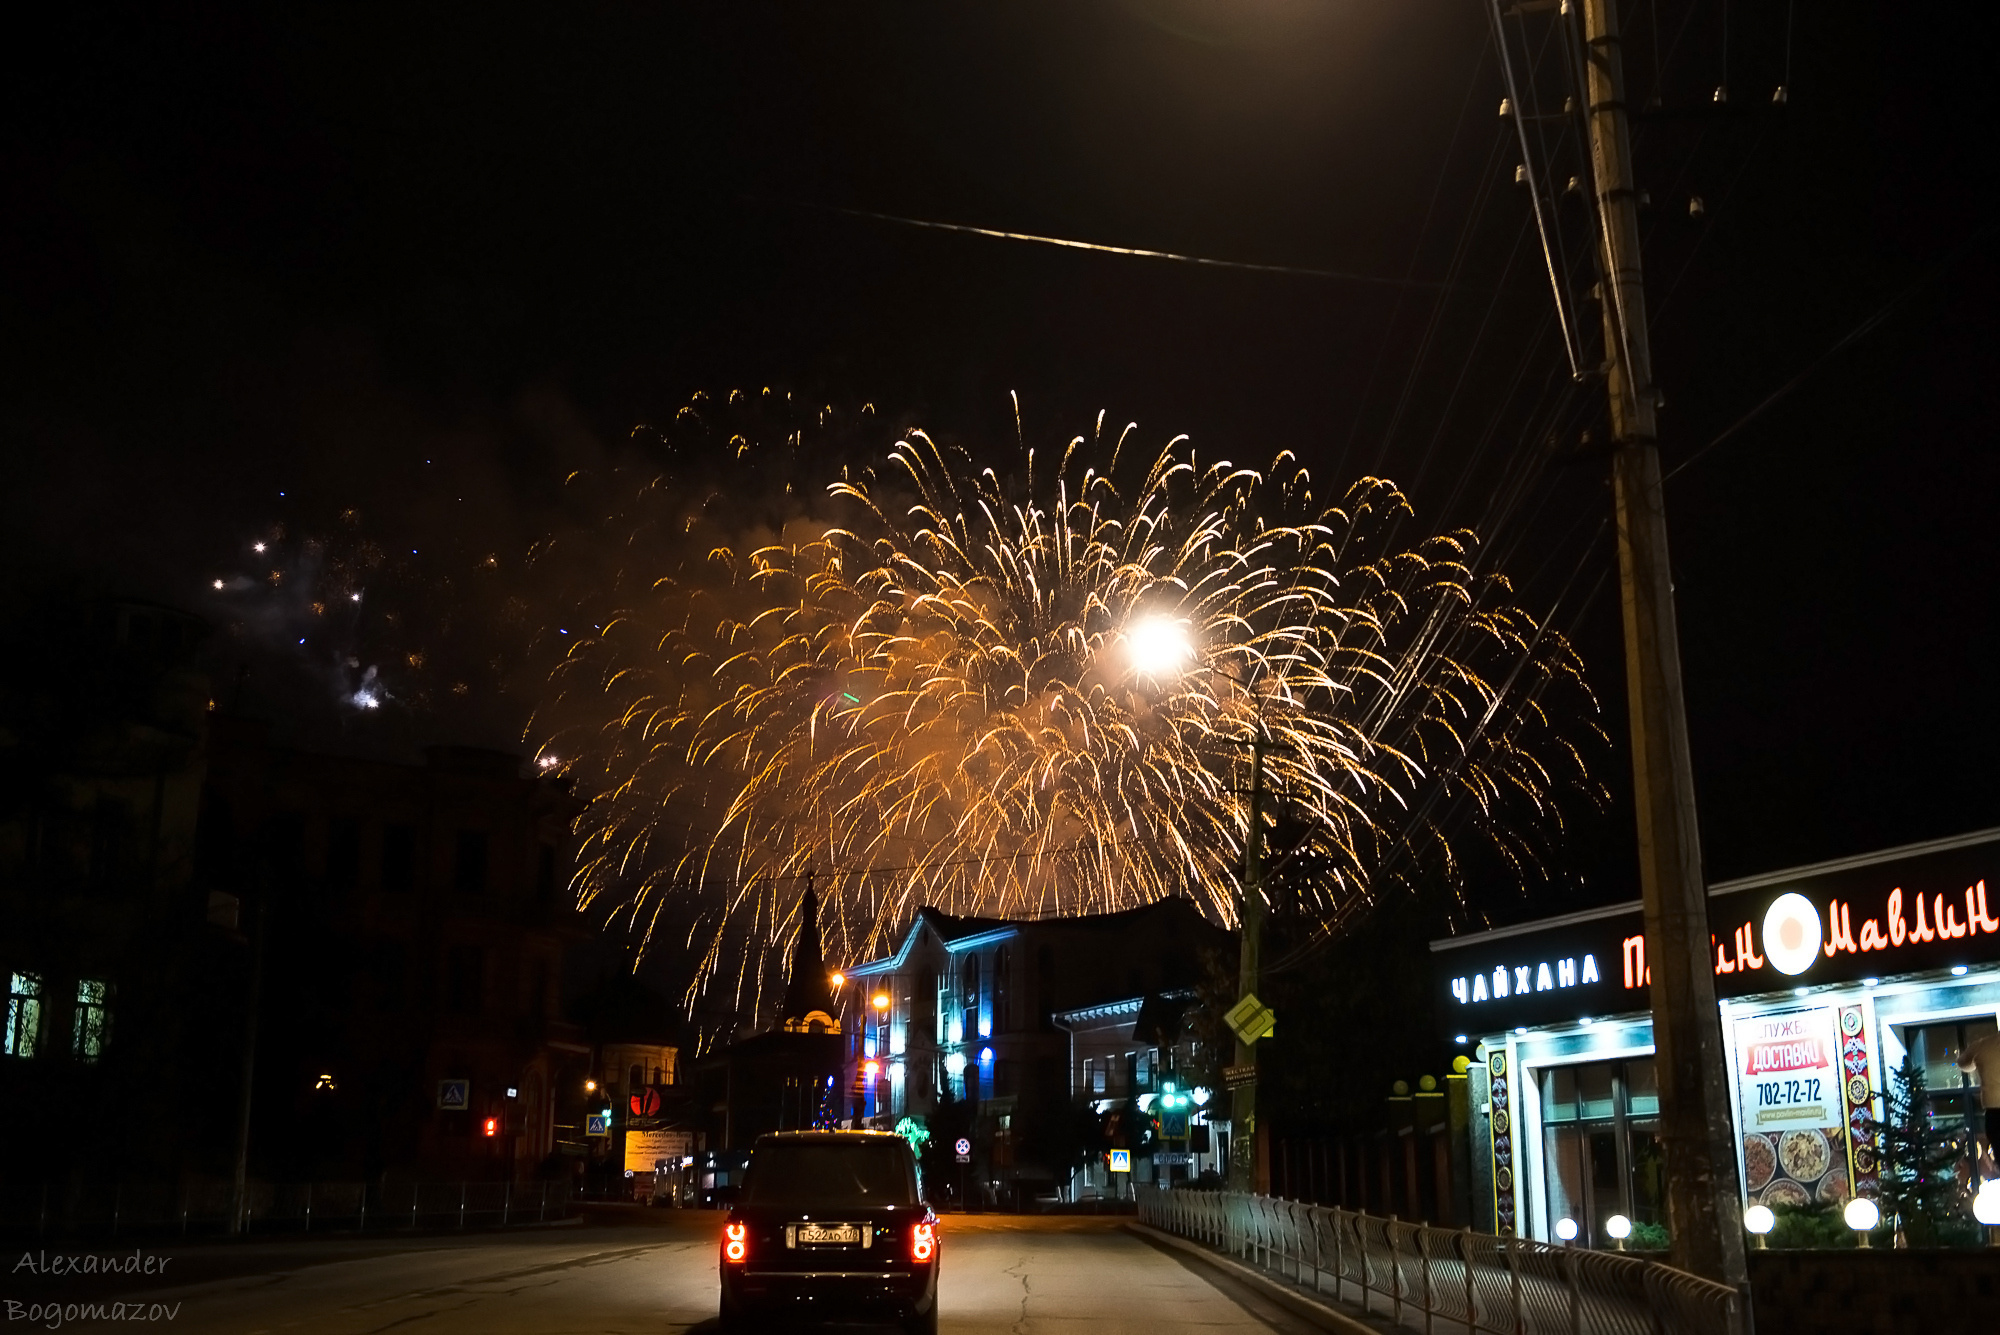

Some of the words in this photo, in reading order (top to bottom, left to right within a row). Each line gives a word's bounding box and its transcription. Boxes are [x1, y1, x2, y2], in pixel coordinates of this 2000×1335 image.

[1824, 879, 2000, 957] Мавлин
[1451, 953, 1600, 1004] ЧАЙХАНА
[1753, 1041, 1820, 1070] ДОСТАВКИ
[1756, 1078, 1822, 1106] 702-72-72
